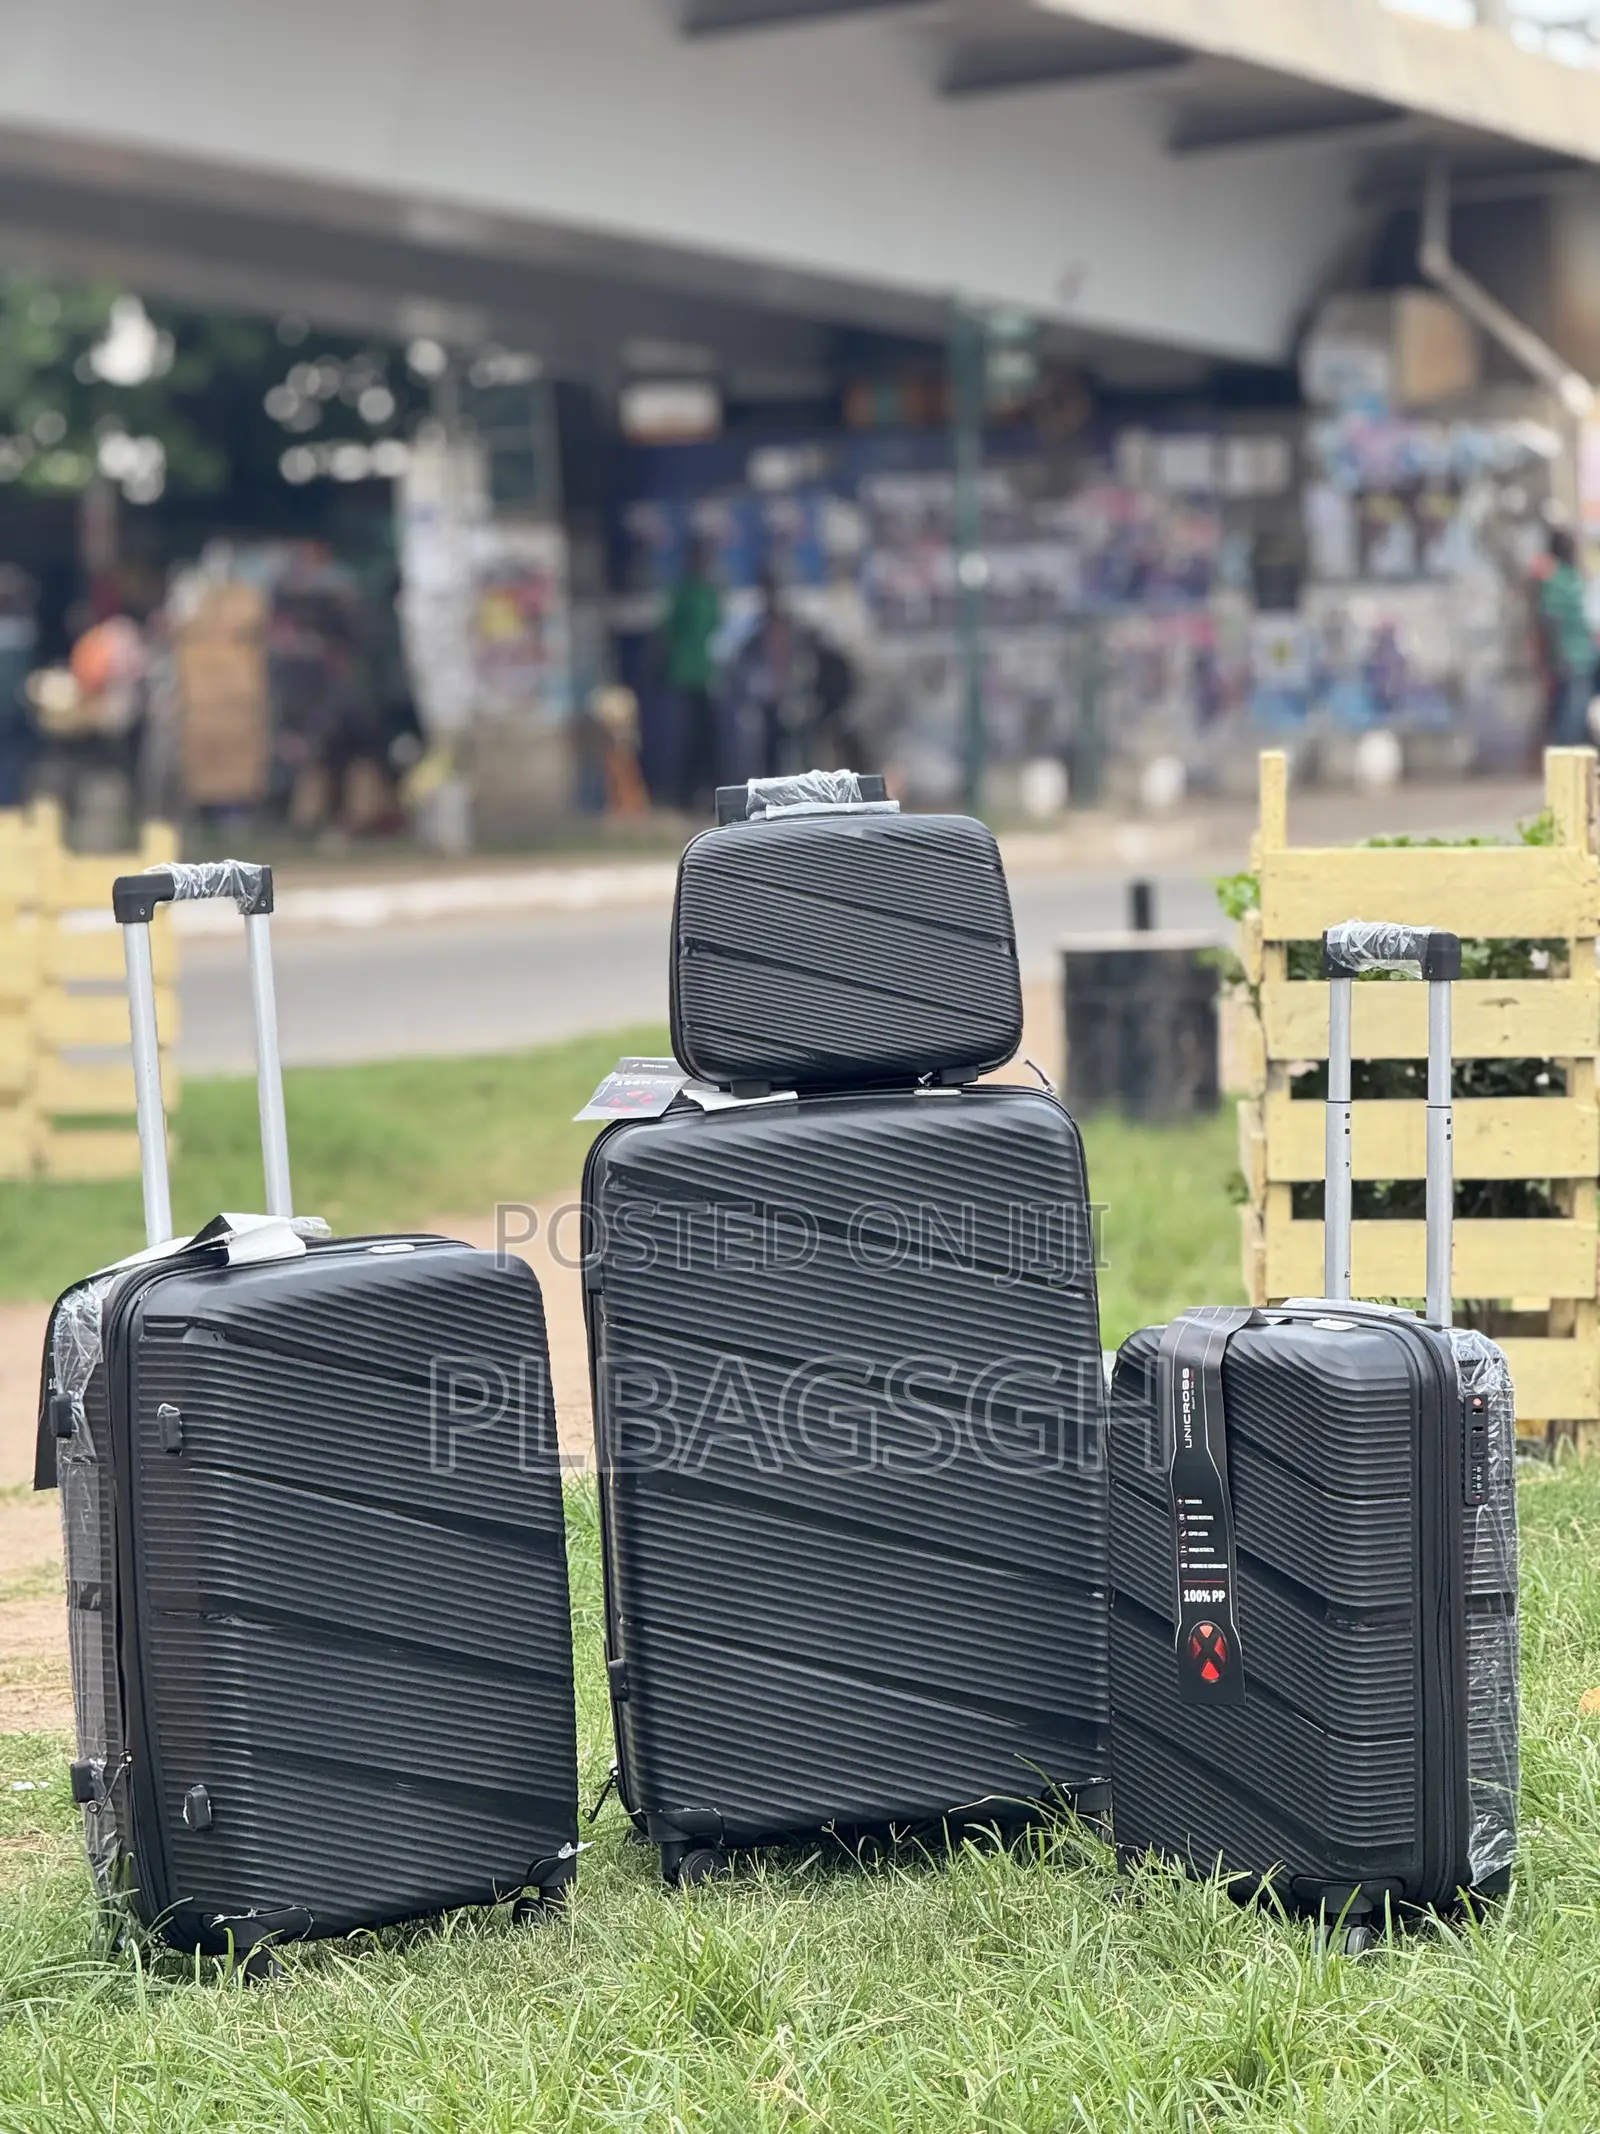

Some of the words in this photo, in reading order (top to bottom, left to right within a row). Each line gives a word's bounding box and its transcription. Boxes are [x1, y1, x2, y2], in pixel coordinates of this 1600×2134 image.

[1182, 1367, 1193, 1449] UNICROSS
[1183, 1589, 1211, 1603] 100%
[1212, 1590, 1226, 1603] PP
